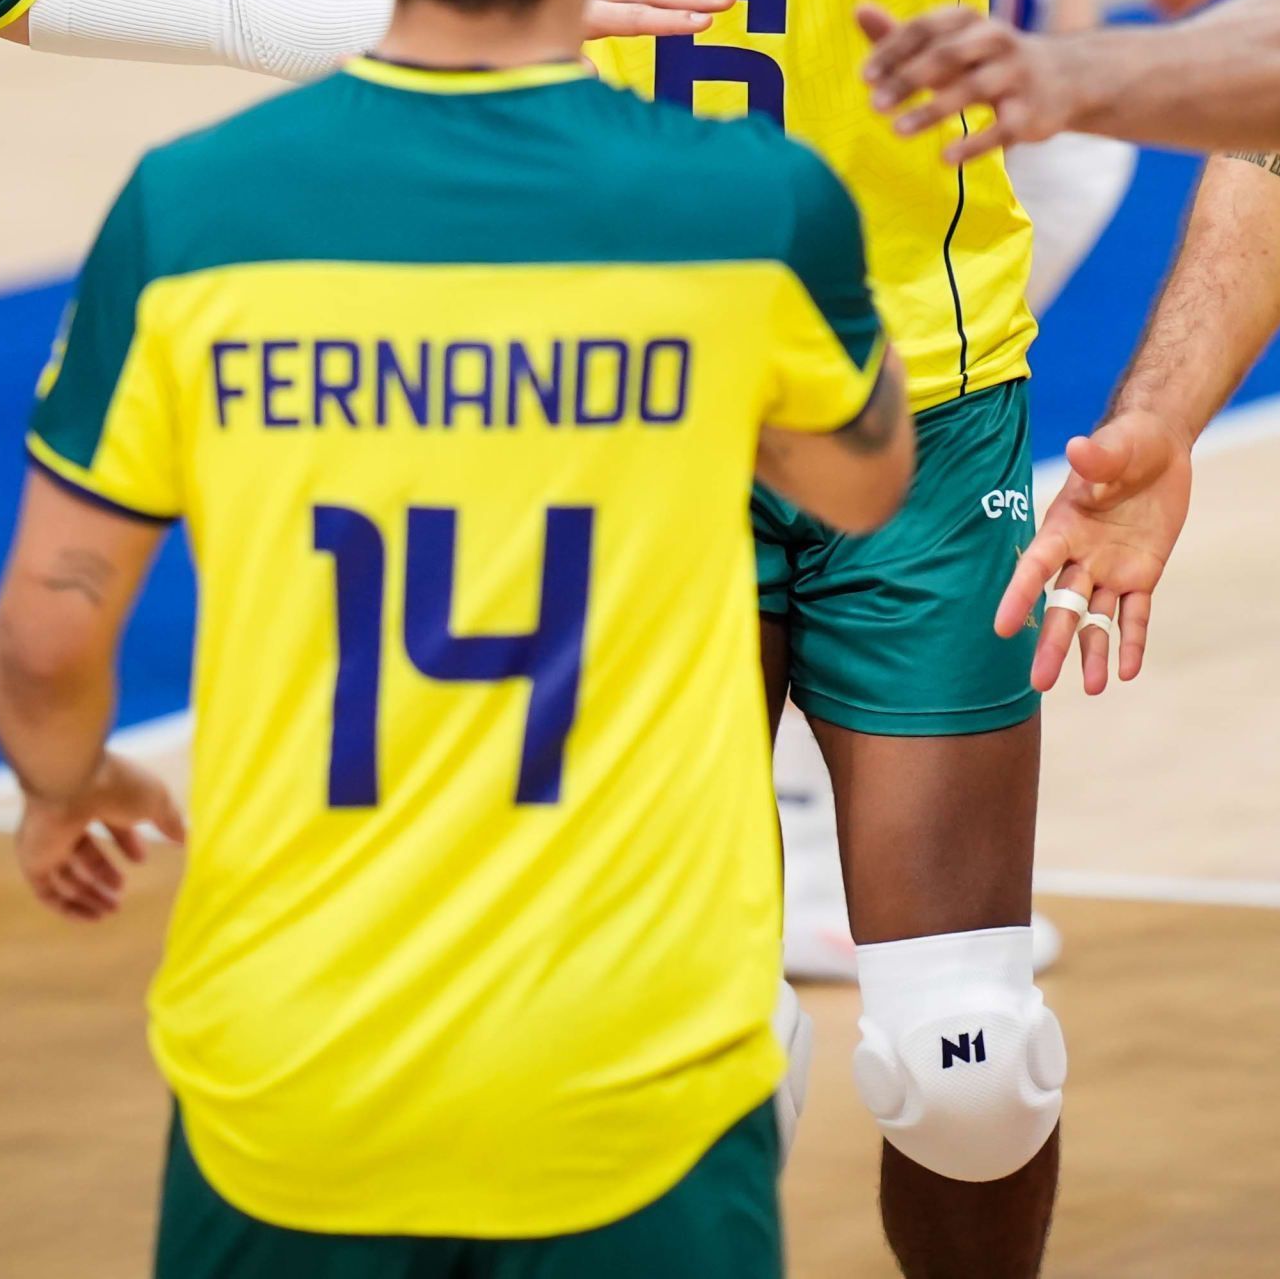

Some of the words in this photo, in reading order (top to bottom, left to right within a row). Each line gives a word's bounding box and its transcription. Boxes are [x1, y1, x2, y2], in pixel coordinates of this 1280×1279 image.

[210, 338, 690, 430] FERNANDO
[312, 504, 595, 808] 14
[941, 1028, 987, 1069] N1
